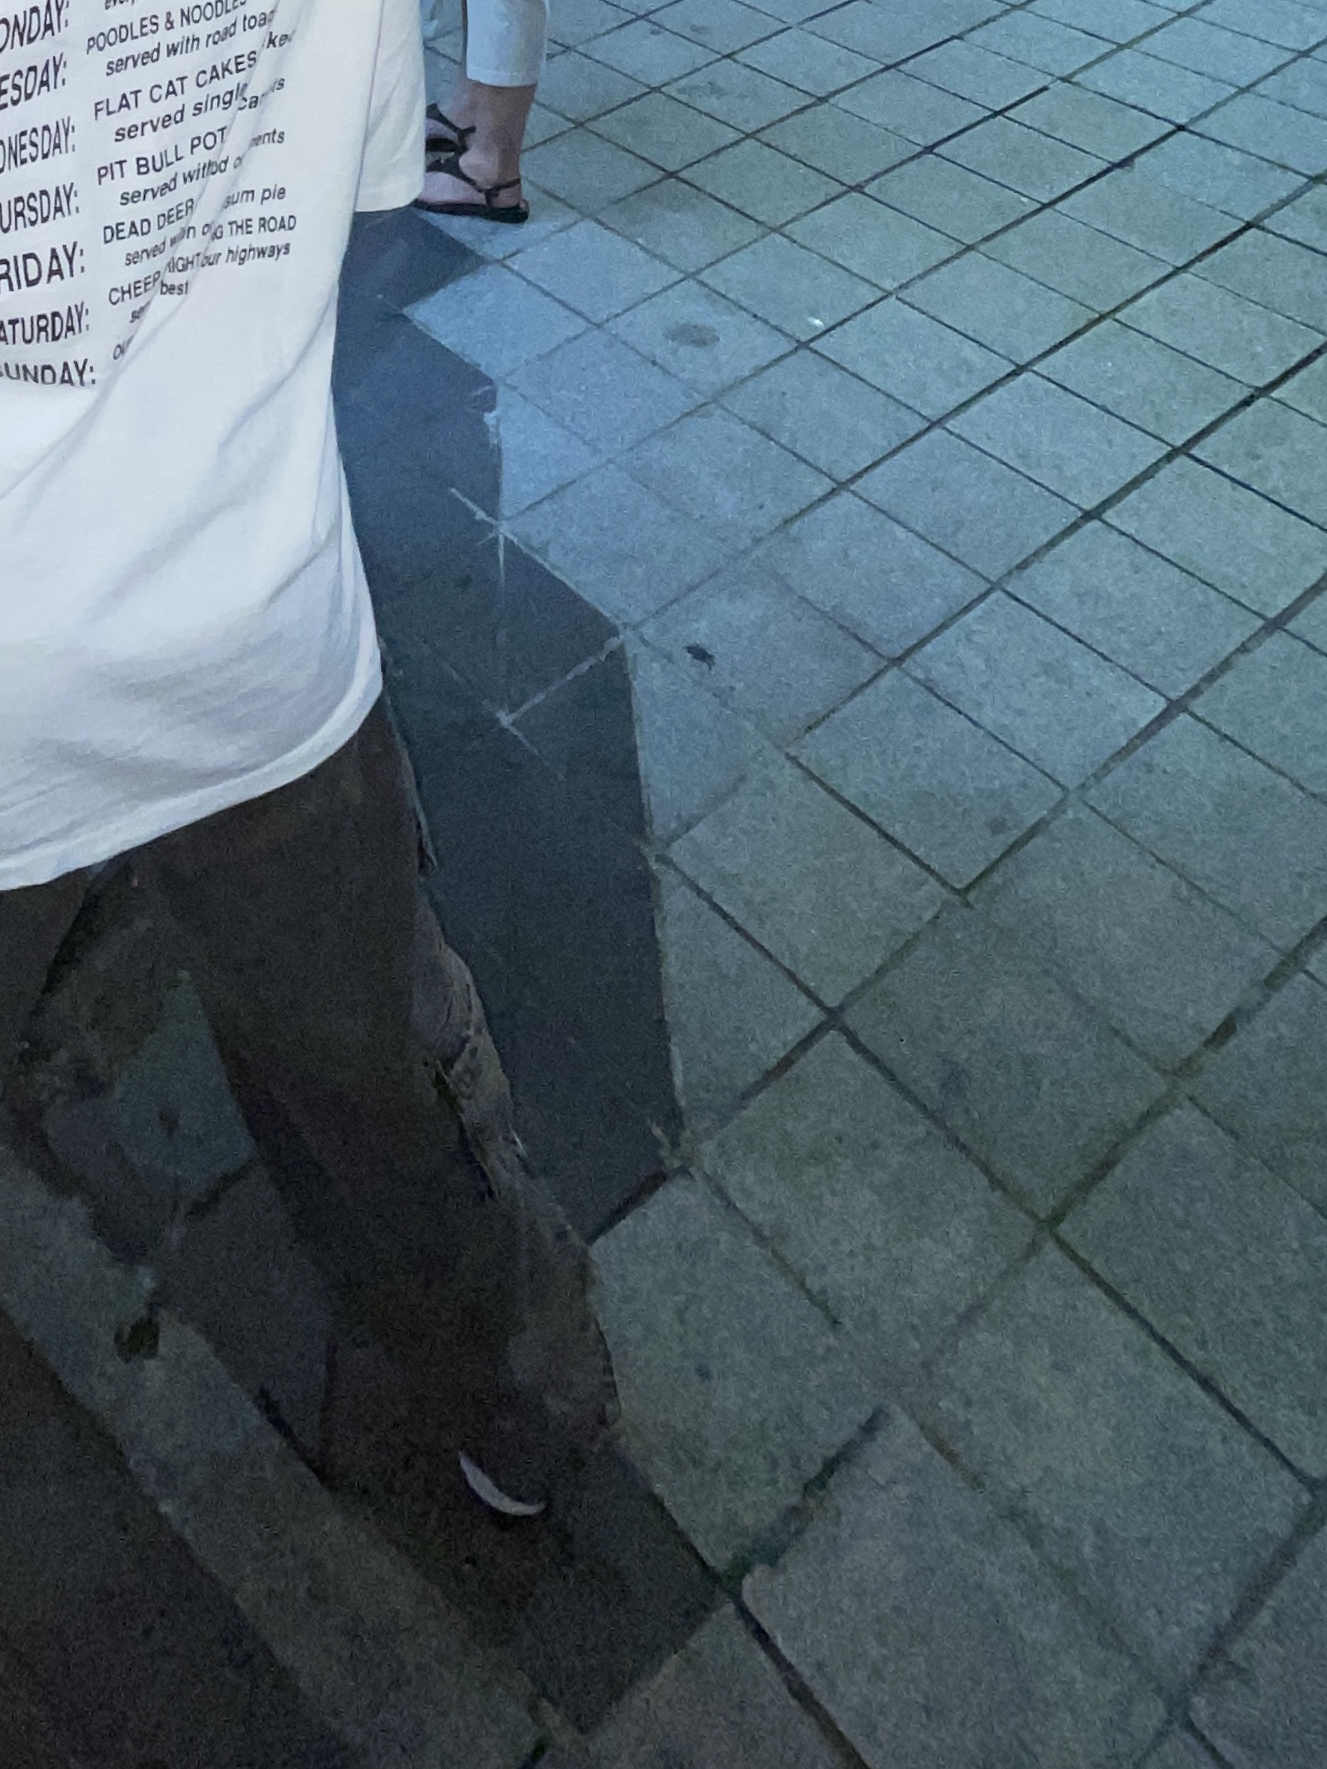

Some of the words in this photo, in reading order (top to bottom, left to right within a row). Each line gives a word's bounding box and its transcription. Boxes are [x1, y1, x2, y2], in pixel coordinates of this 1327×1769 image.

[86, 15, 159, 56] POODLES
[165, 11, 175, 30] &
[106, 42, 161, 77] served
[166, 34, 200, 58] with
[94, 89, 142, 121] FLAT
[149, 76, 188, 104] CAT
[195, 50, 257, 88] CAKES
[114, 103, 185, 143] served
[97, 160, 127, 185] PIT
[136, 143, 184, 176] BULL
[190, 125, 227, 155] POT
[119, 171, 178, 206] served
[261, 184, 286, 206] pie
[103, 218, 151, 244] DEAD
[157, 198, 194, 230] DEER
[227, 220, 253, 236] THE
[258, 215, 297, 234] ROAD
[125, 237, 166, 266] served
[225, 241, 291, 266] highways
